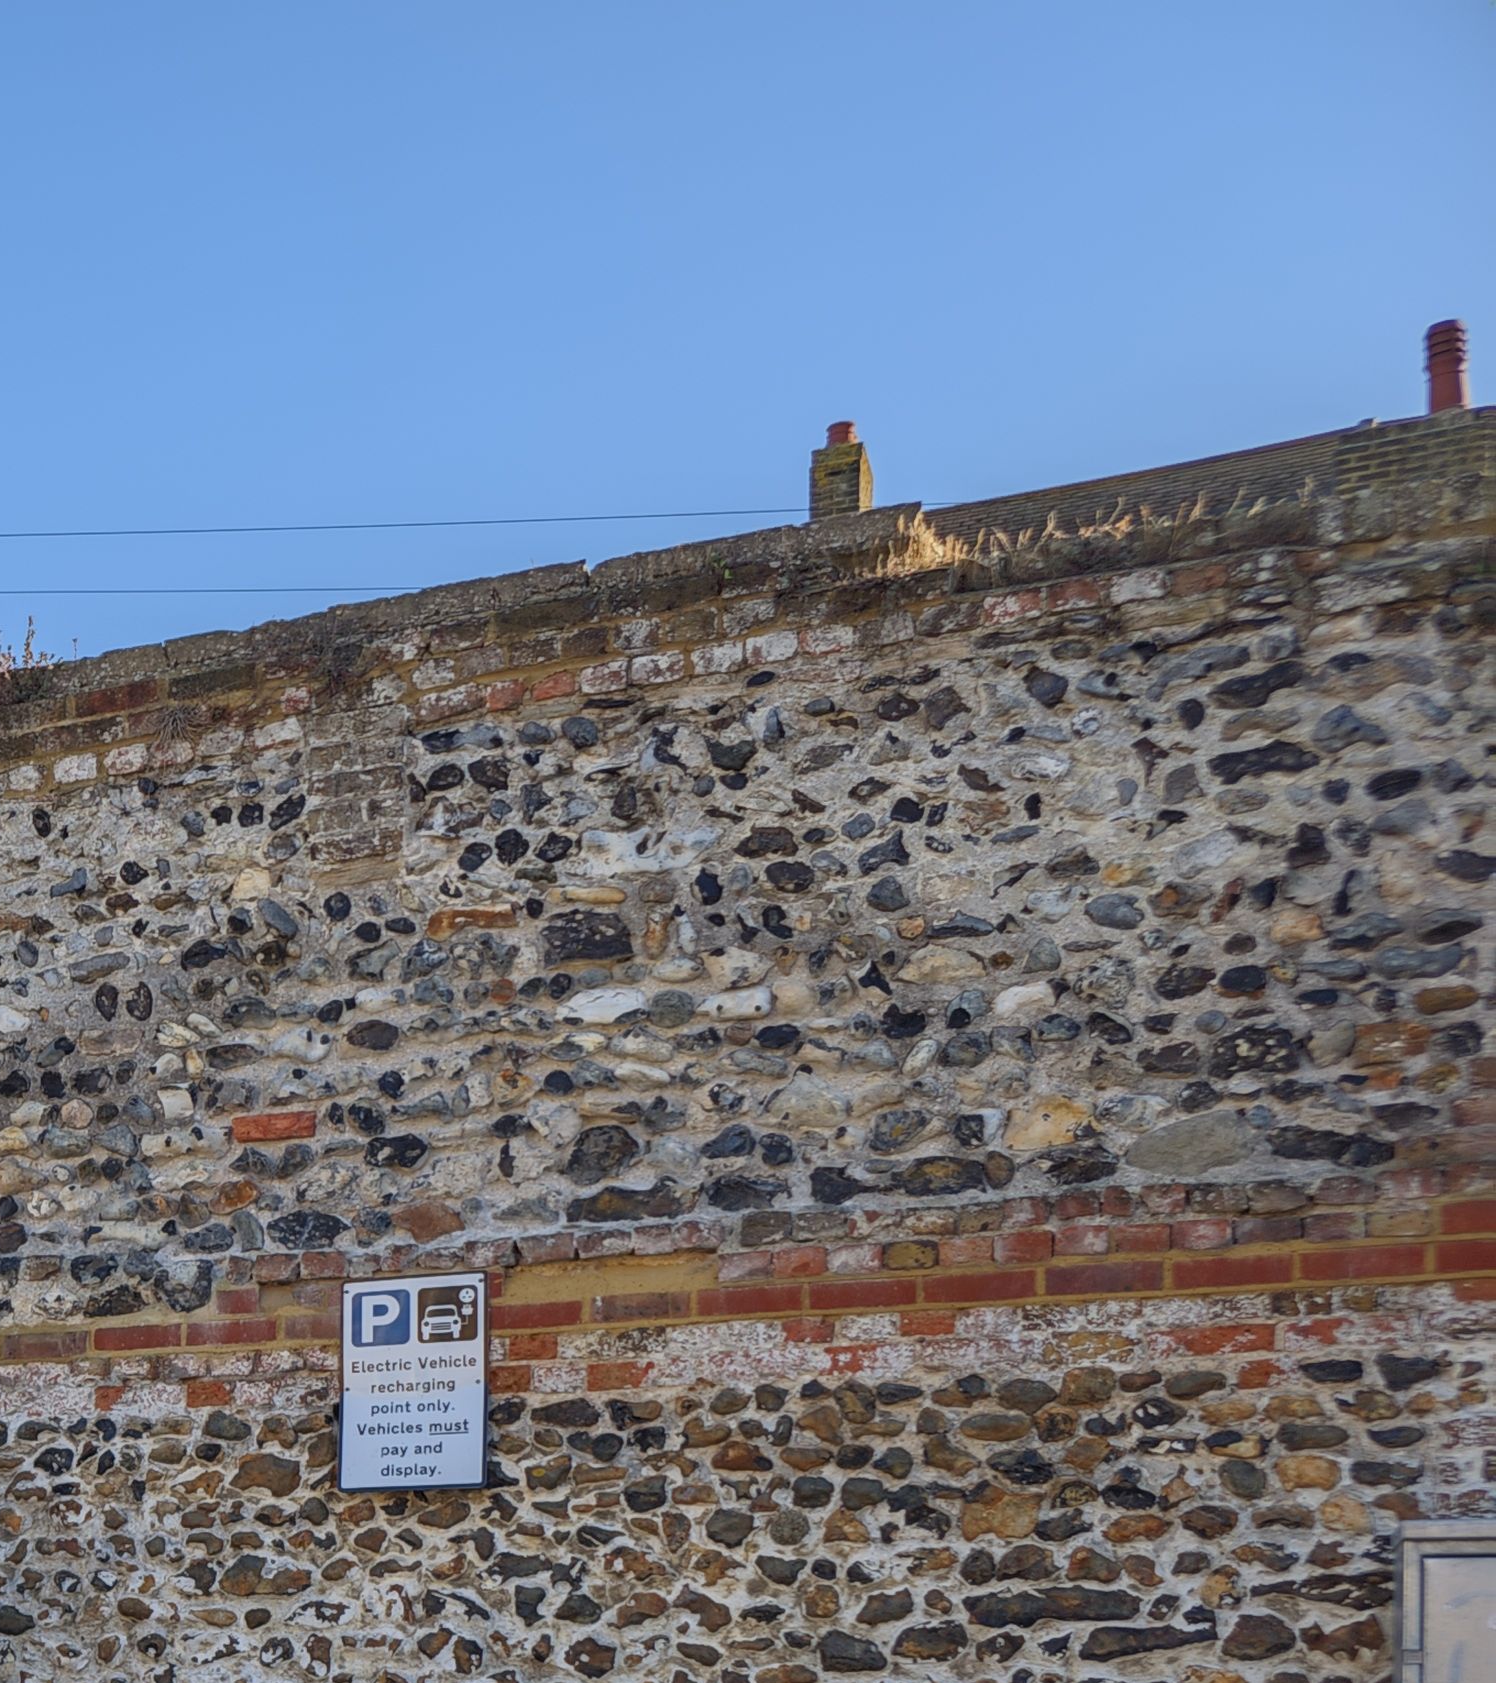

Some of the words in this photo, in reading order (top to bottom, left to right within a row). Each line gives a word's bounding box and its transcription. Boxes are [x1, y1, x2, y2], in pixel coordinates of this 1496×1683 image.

[361, 1294, 401, 1344] P
[352, 1358, 412, 1374] Electric
[418, 1354, 477, 1370] Vehicle
[371, 1378, 456, 1394] recharging
[371, 1401, 412, 1417] point
[417, 1399, 455, 1415] only.
[357, 1420, 423, 1436] Vehicles
[429, 1419, 469, 1435] must
[381, 1445, 408, 1458] pay
[414, 1441, 443, 1455] and
[381, 1464, 442, 1478] display.
